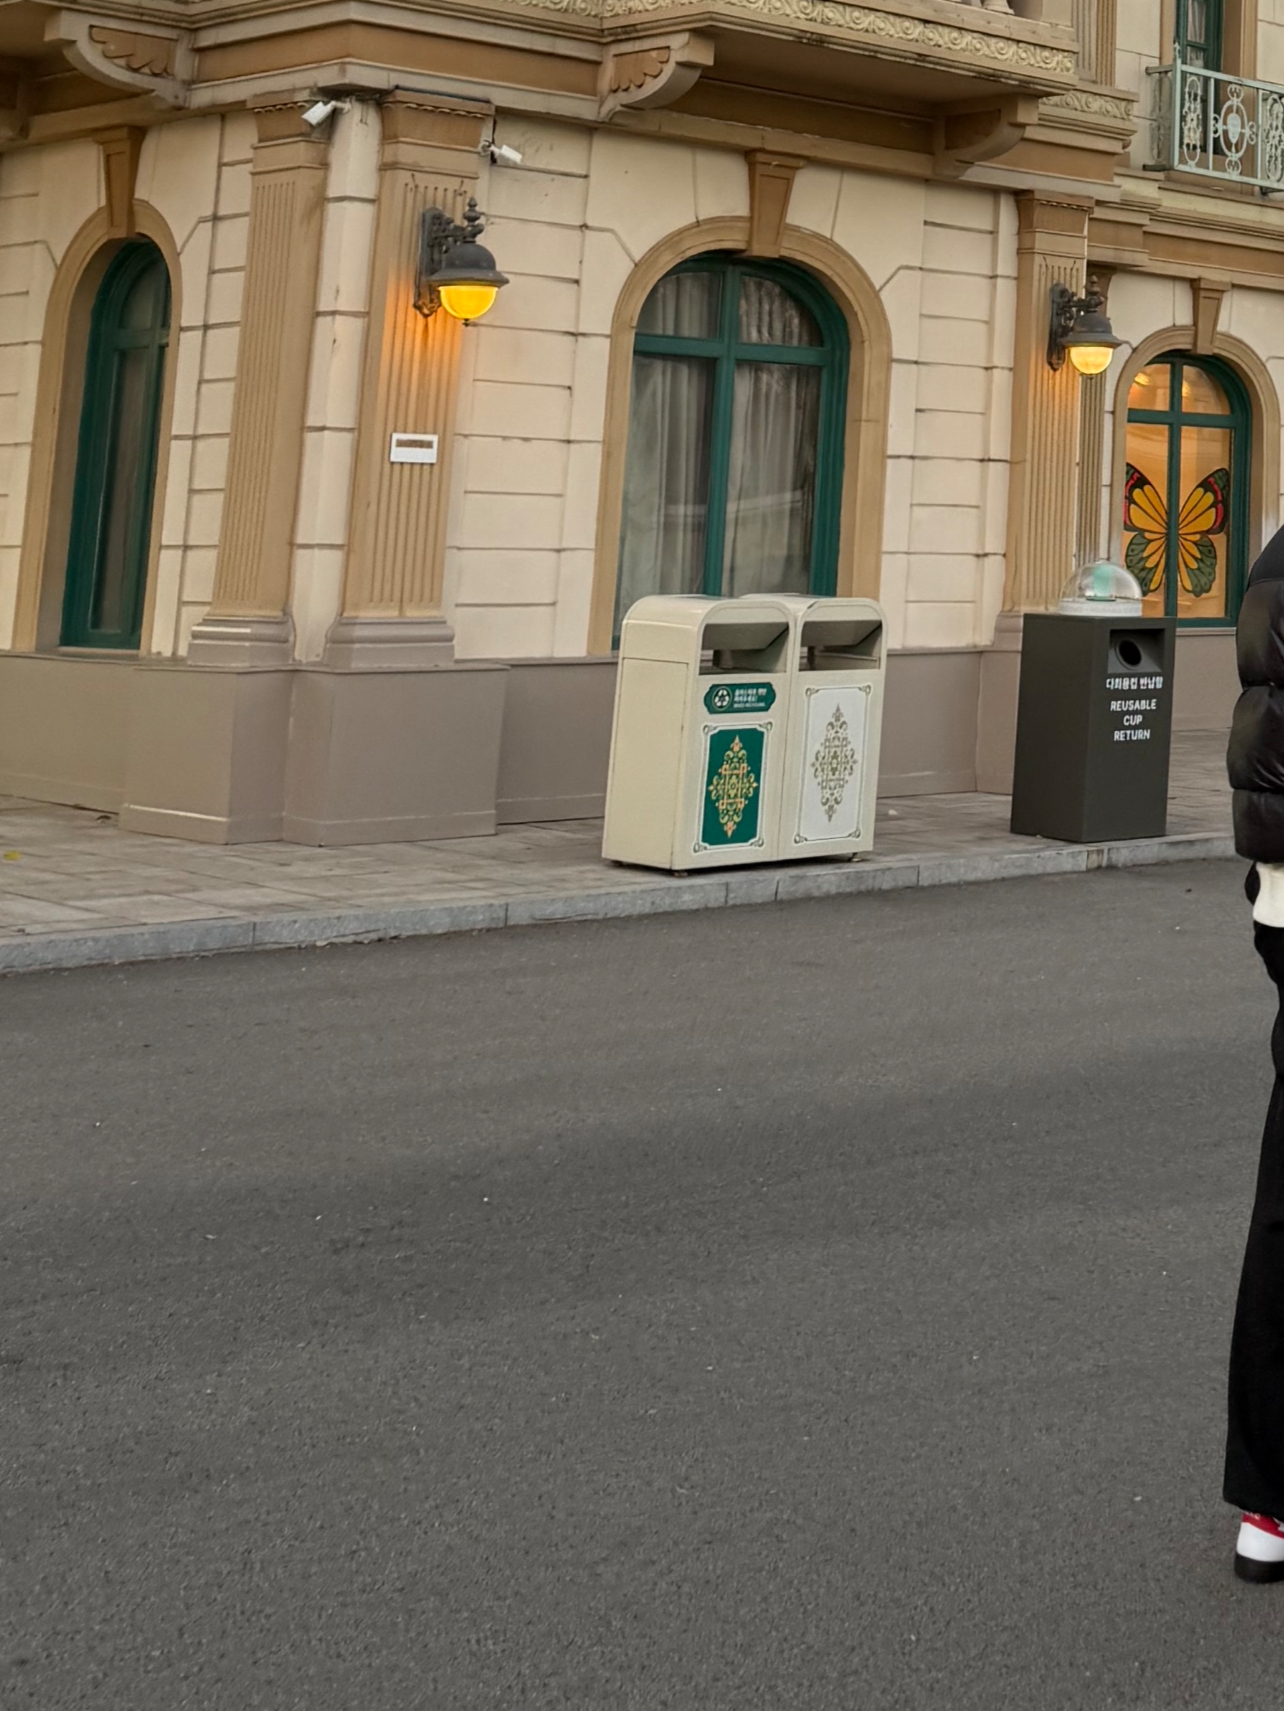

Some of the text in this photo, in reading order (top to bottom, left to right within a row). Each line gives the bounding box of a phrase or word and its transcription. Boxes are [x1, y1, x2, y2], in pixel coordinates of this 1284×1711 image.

[1110, 698, 1157, 711] REUSABLE
[1123, 714, 1143, 726] CUP
[1114, 729, 1151, 741] RETURN
